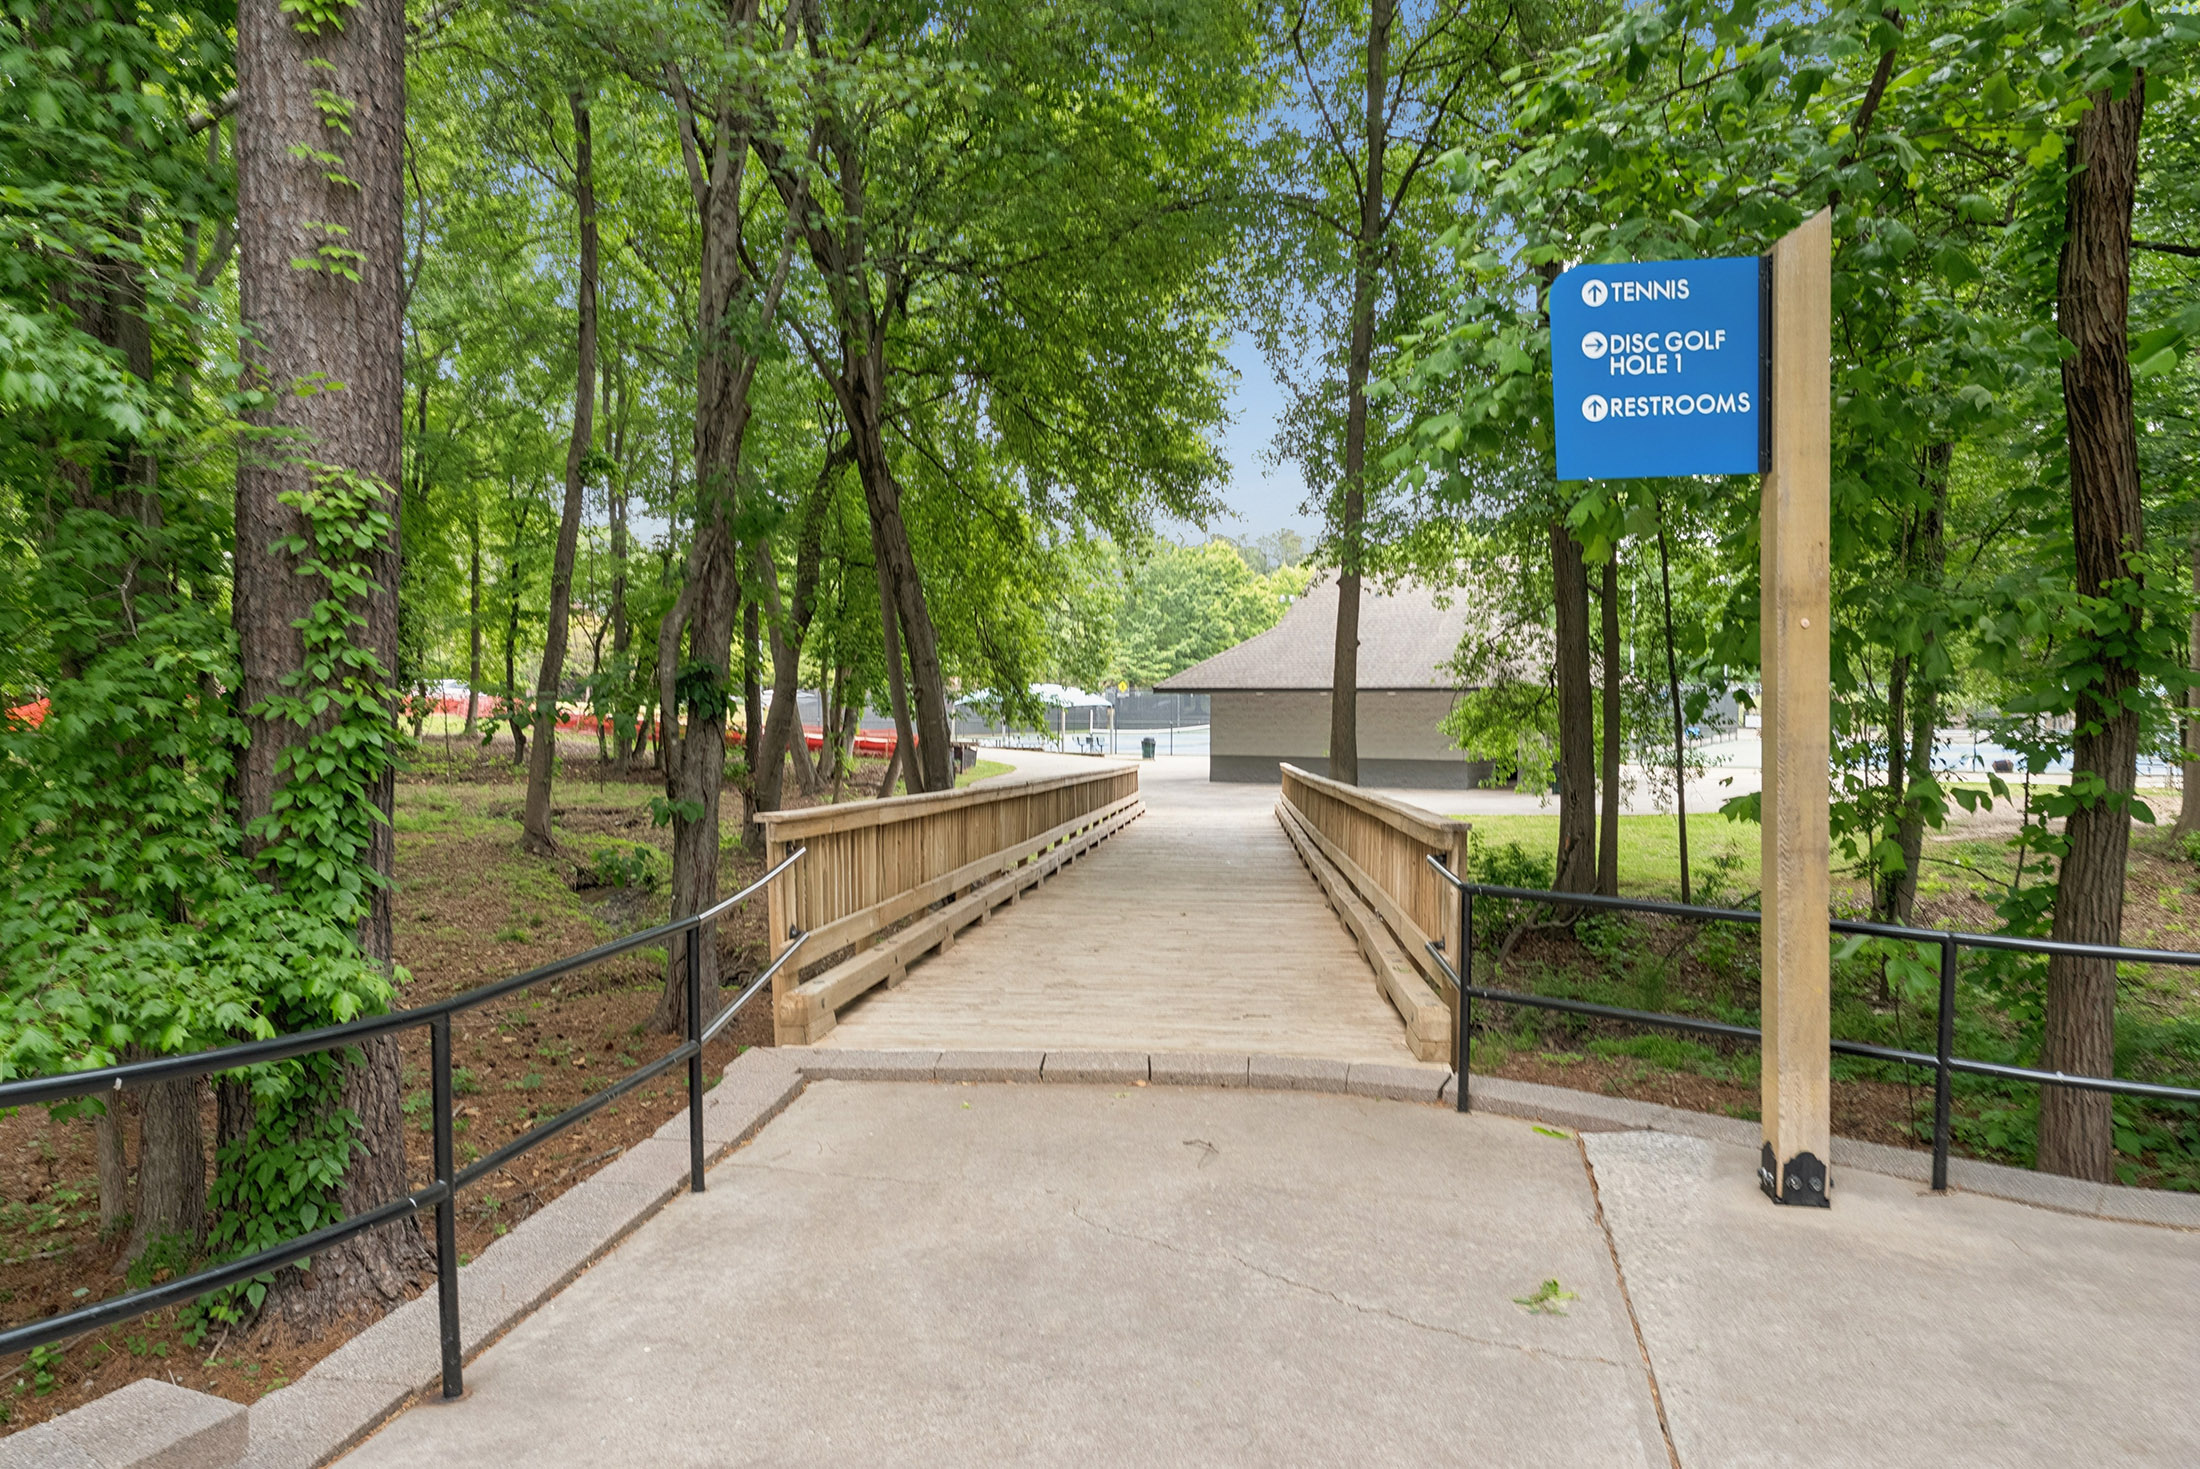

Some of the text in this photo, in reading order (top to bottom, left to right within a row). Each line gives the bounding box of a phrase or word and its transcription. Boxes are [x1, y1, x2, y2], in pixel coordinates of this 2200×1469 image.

[1610, 278, 1691, 303] TENNIS
[1609, 329, 1727, 355] DISC GOLF
[1609, 353, 1682, 376] HOLE 1
[1610, 391, 1751, 418] RESTROOMS
